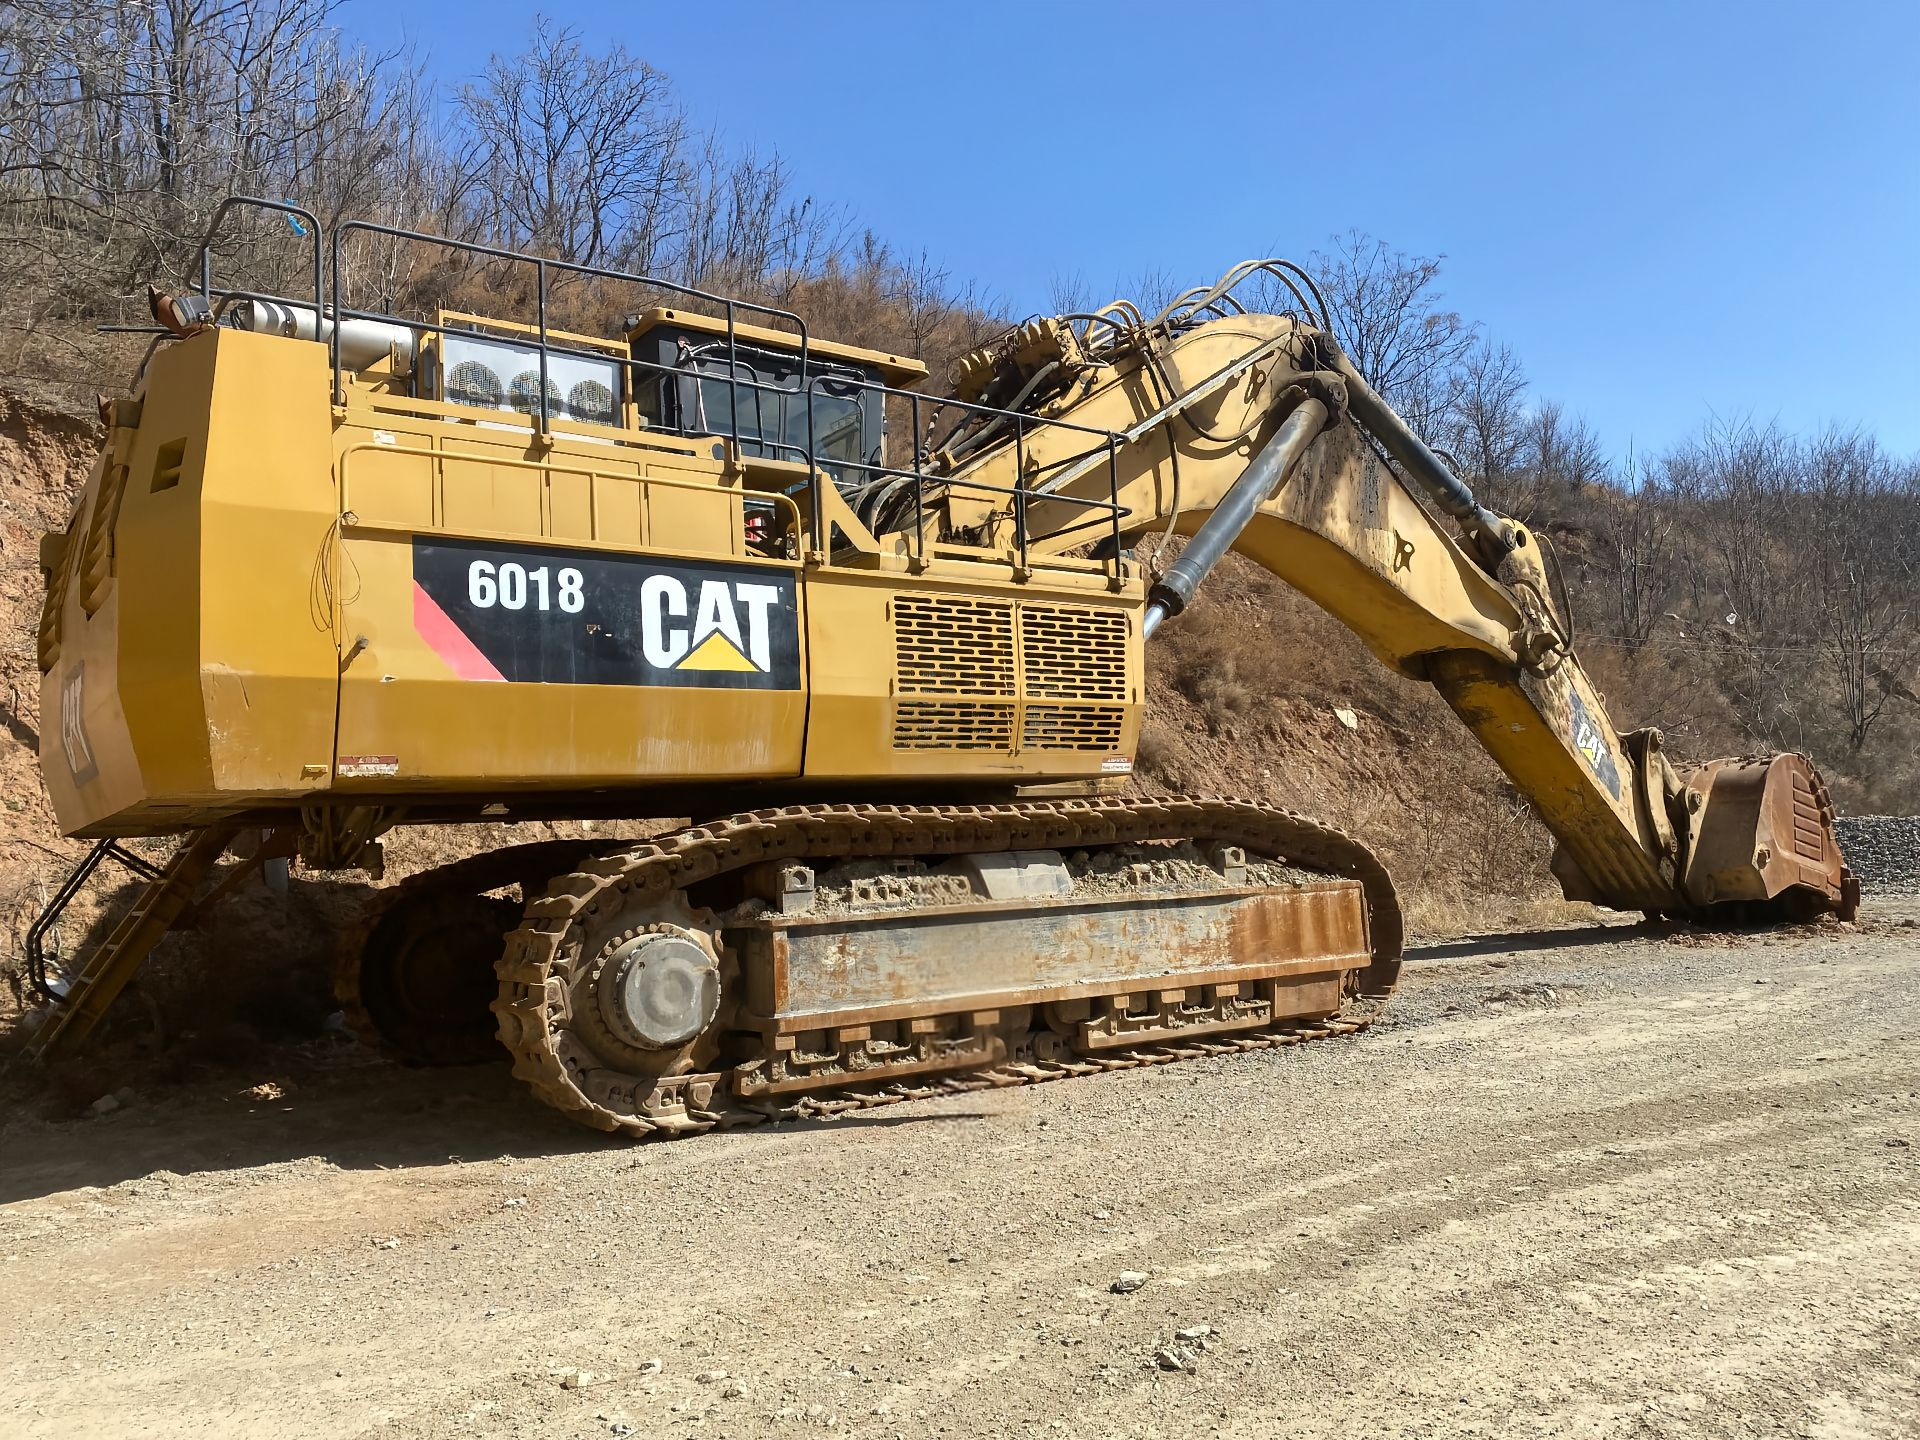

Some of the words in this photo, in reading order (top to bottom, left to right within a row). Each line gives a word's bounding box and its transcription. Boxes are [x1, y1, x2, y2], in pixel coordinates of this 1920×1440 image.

[468, 560, 585, 614] 6018
[640, 574, 779, 673] CAT
[1577, 722, 1606, 769] CAT
